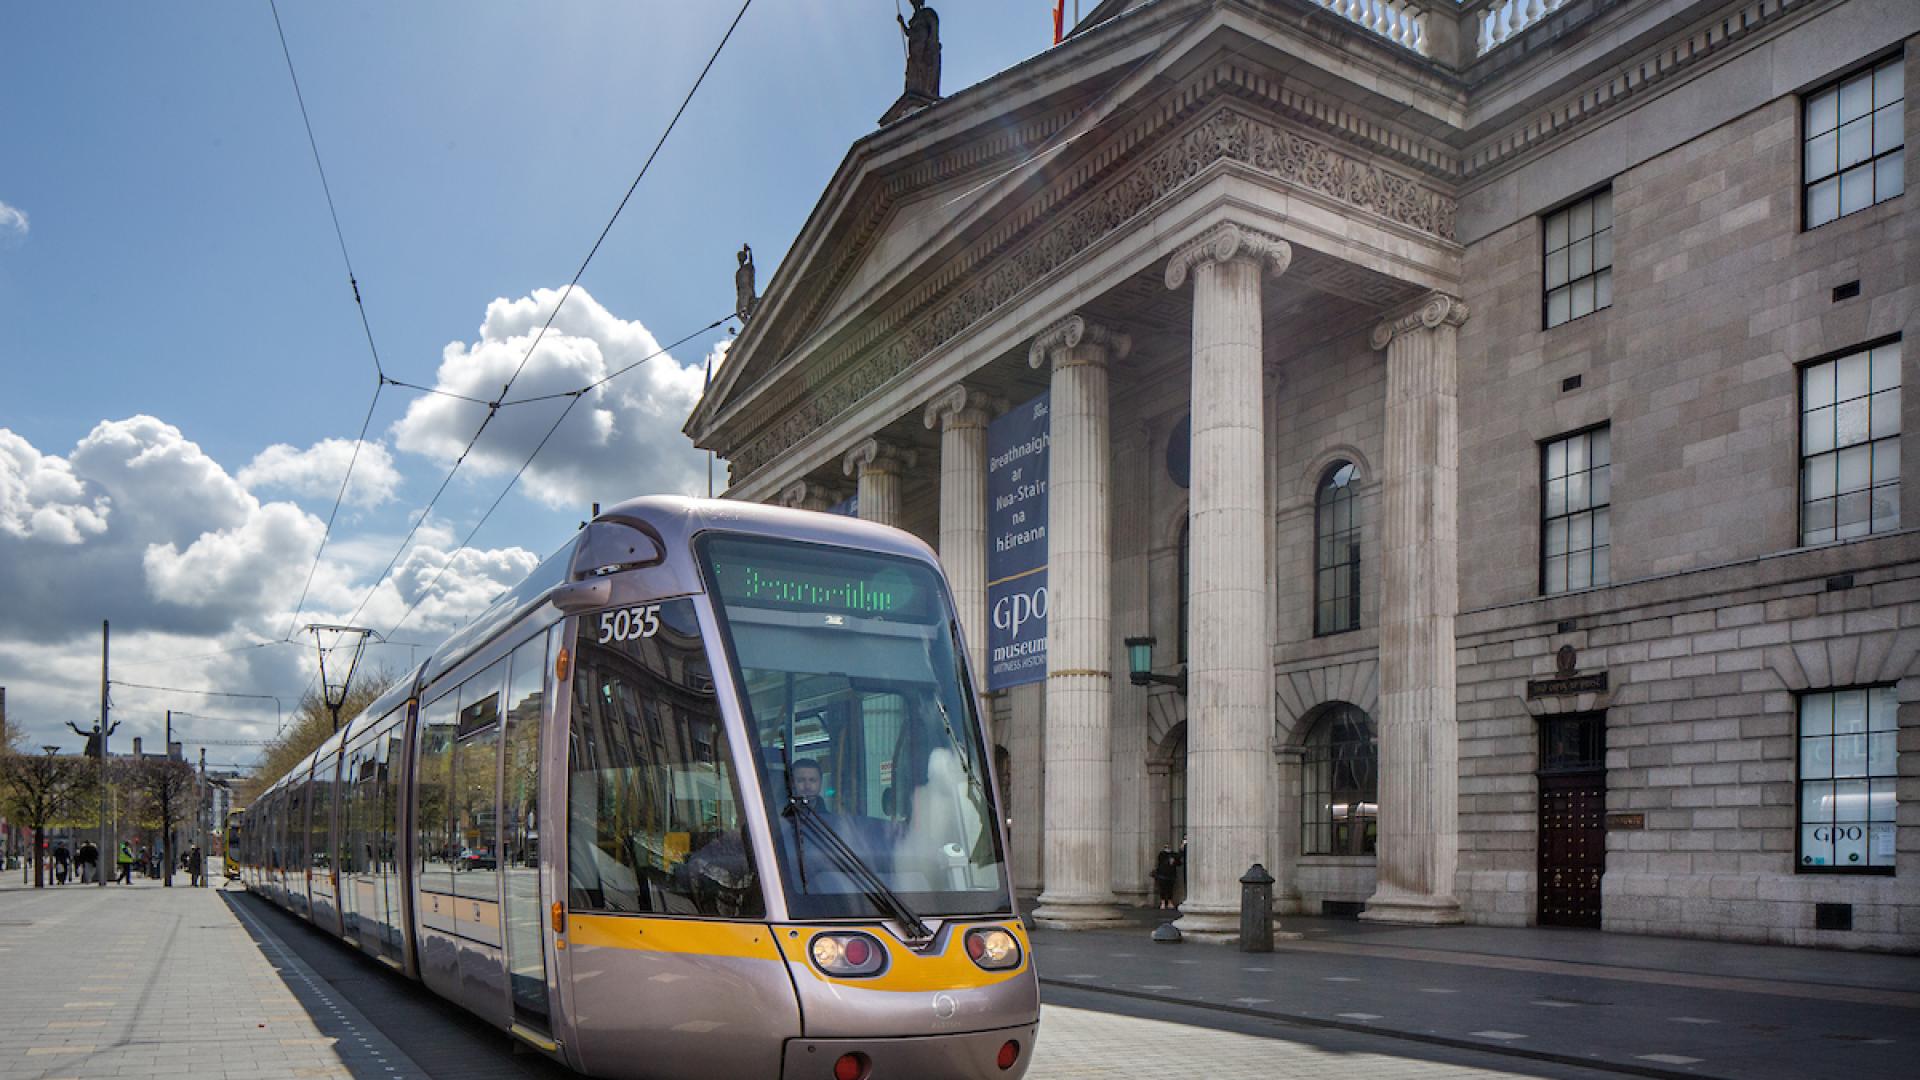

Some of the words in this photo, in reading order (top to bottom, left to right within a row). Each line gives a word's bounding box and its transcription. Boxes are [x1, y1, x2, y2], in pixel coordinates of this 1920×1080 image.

[990, 432, 1050, 472] Breathnaigh
[1010, 467, 1023, 482] ar
[1012, 511, 1026, 526] na
[598, 605, 661, 645] 5035
[993, 637, 1048, 662] museum
